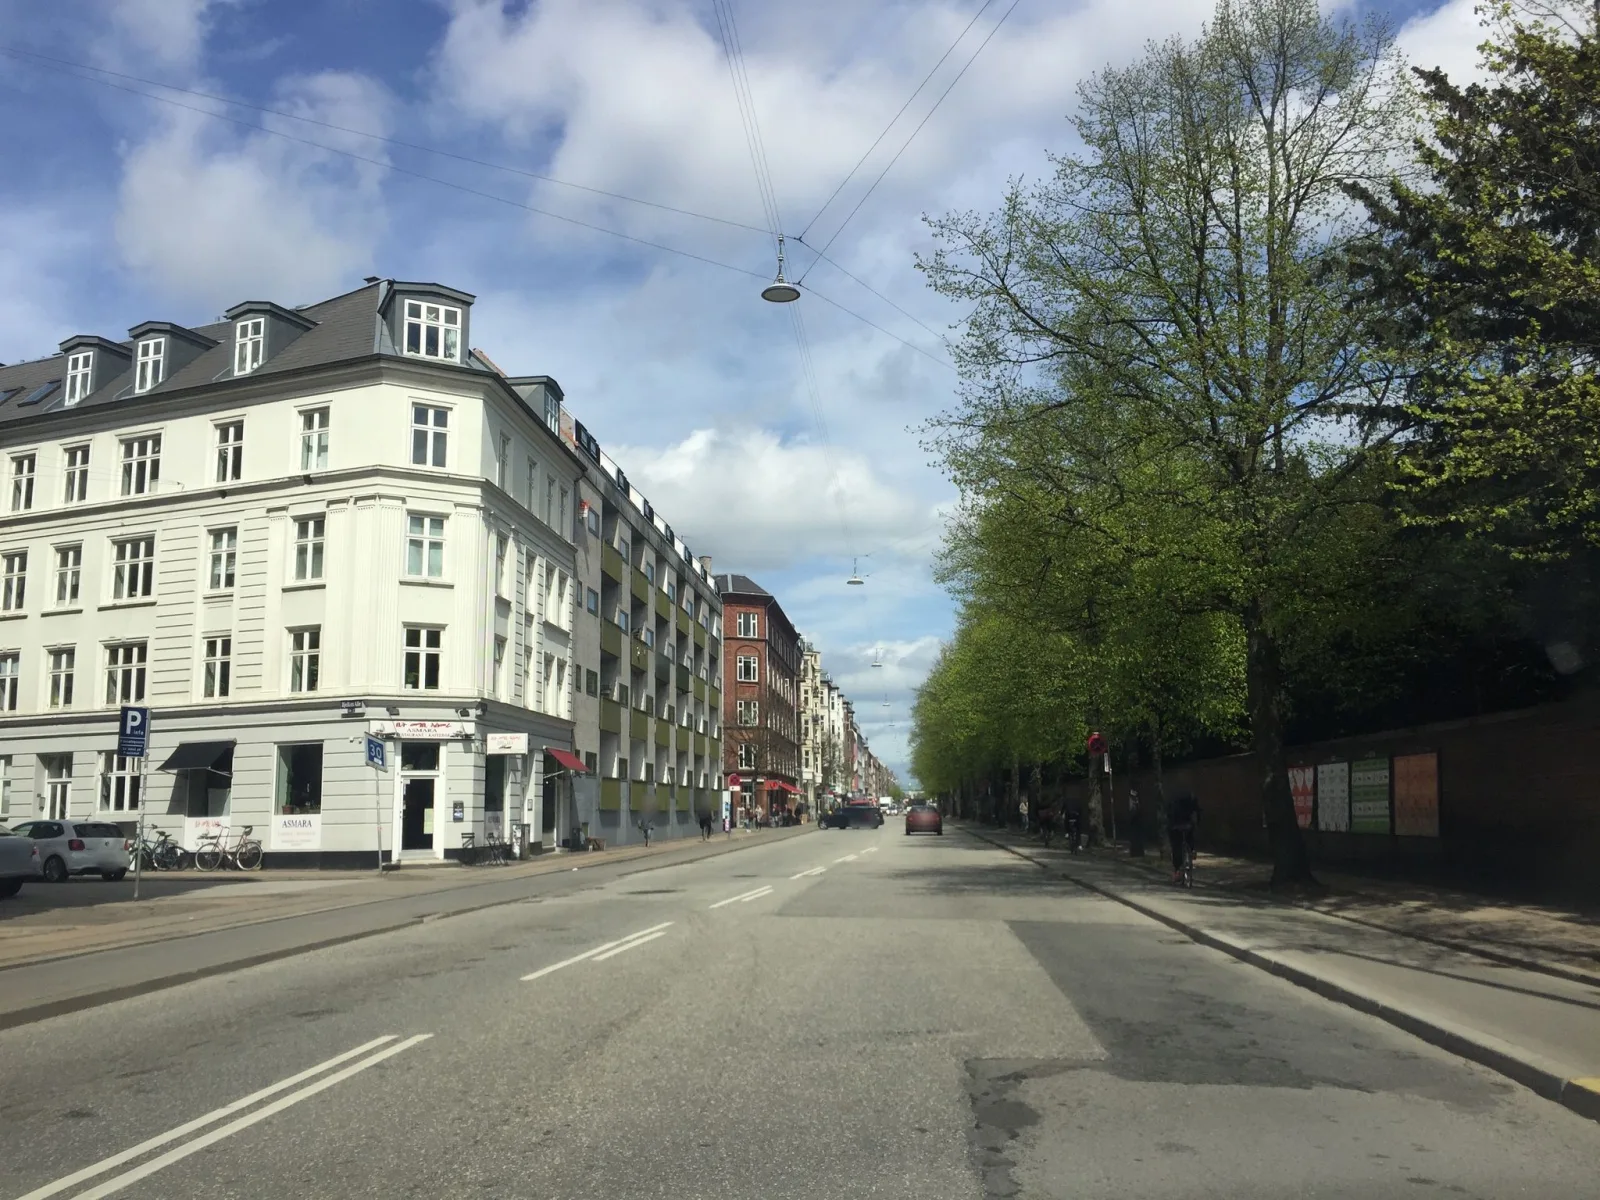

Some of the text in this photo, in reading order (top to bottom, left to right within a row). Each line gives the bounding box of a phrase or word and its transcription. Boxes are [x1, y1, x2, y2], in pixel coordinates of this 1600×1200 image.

[126, 710, 141, 735] P
[369, 744, 382, 759] 30
[282, 819, 312, 829] ASMARA
